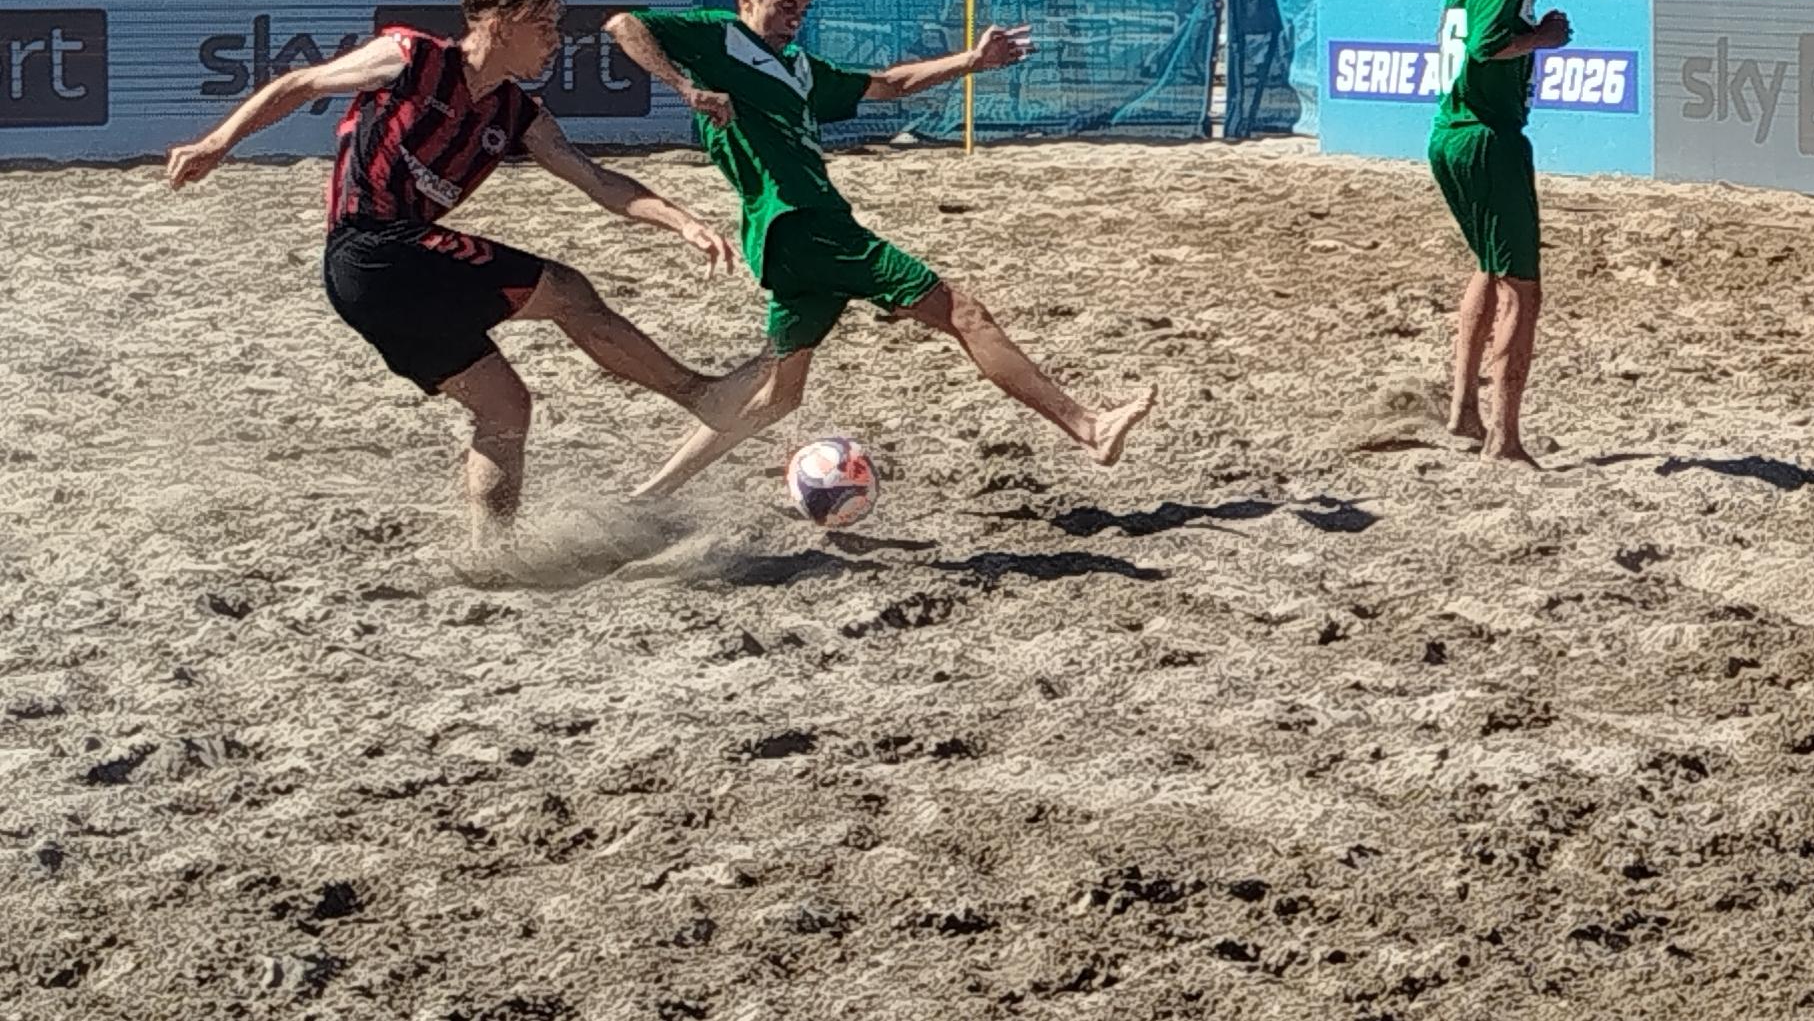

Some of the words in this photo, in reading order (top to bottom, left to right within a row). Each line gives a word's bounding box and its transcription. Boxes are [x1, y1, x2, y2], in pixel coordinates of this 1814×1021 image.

[1336, 49, 1417, 95] SERIE
[1540, 56, 1629, 105] 2026
[1683, 36, 1789, 144] sky
